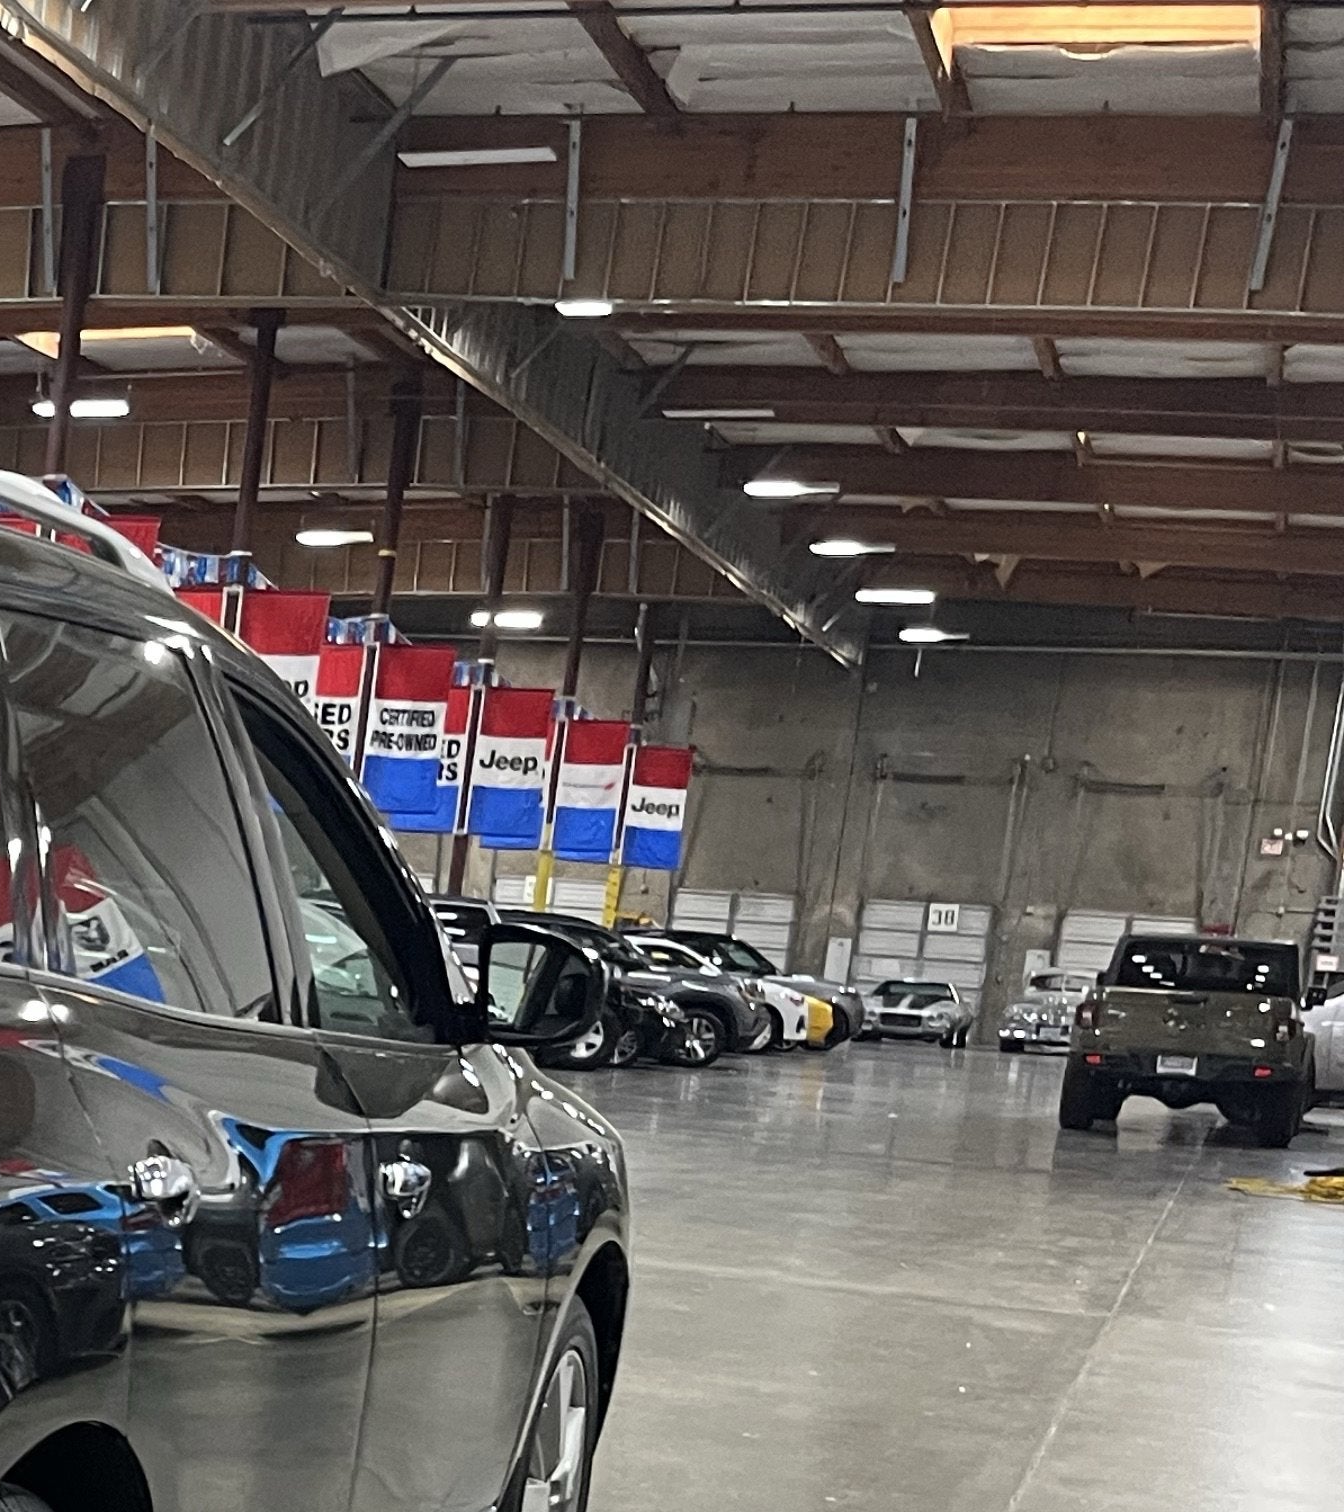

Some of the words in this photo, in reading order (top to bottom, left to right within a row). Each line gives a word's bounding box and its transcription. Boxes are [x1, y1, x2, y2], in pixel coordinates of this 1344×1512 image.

[379, 707, 435, 728] CERTIFIED
[370, 730, 437, 751] PRE-OWNED
[479, 750, 538, 777] Jeep
[631, 798, 679, 819] Jeep
